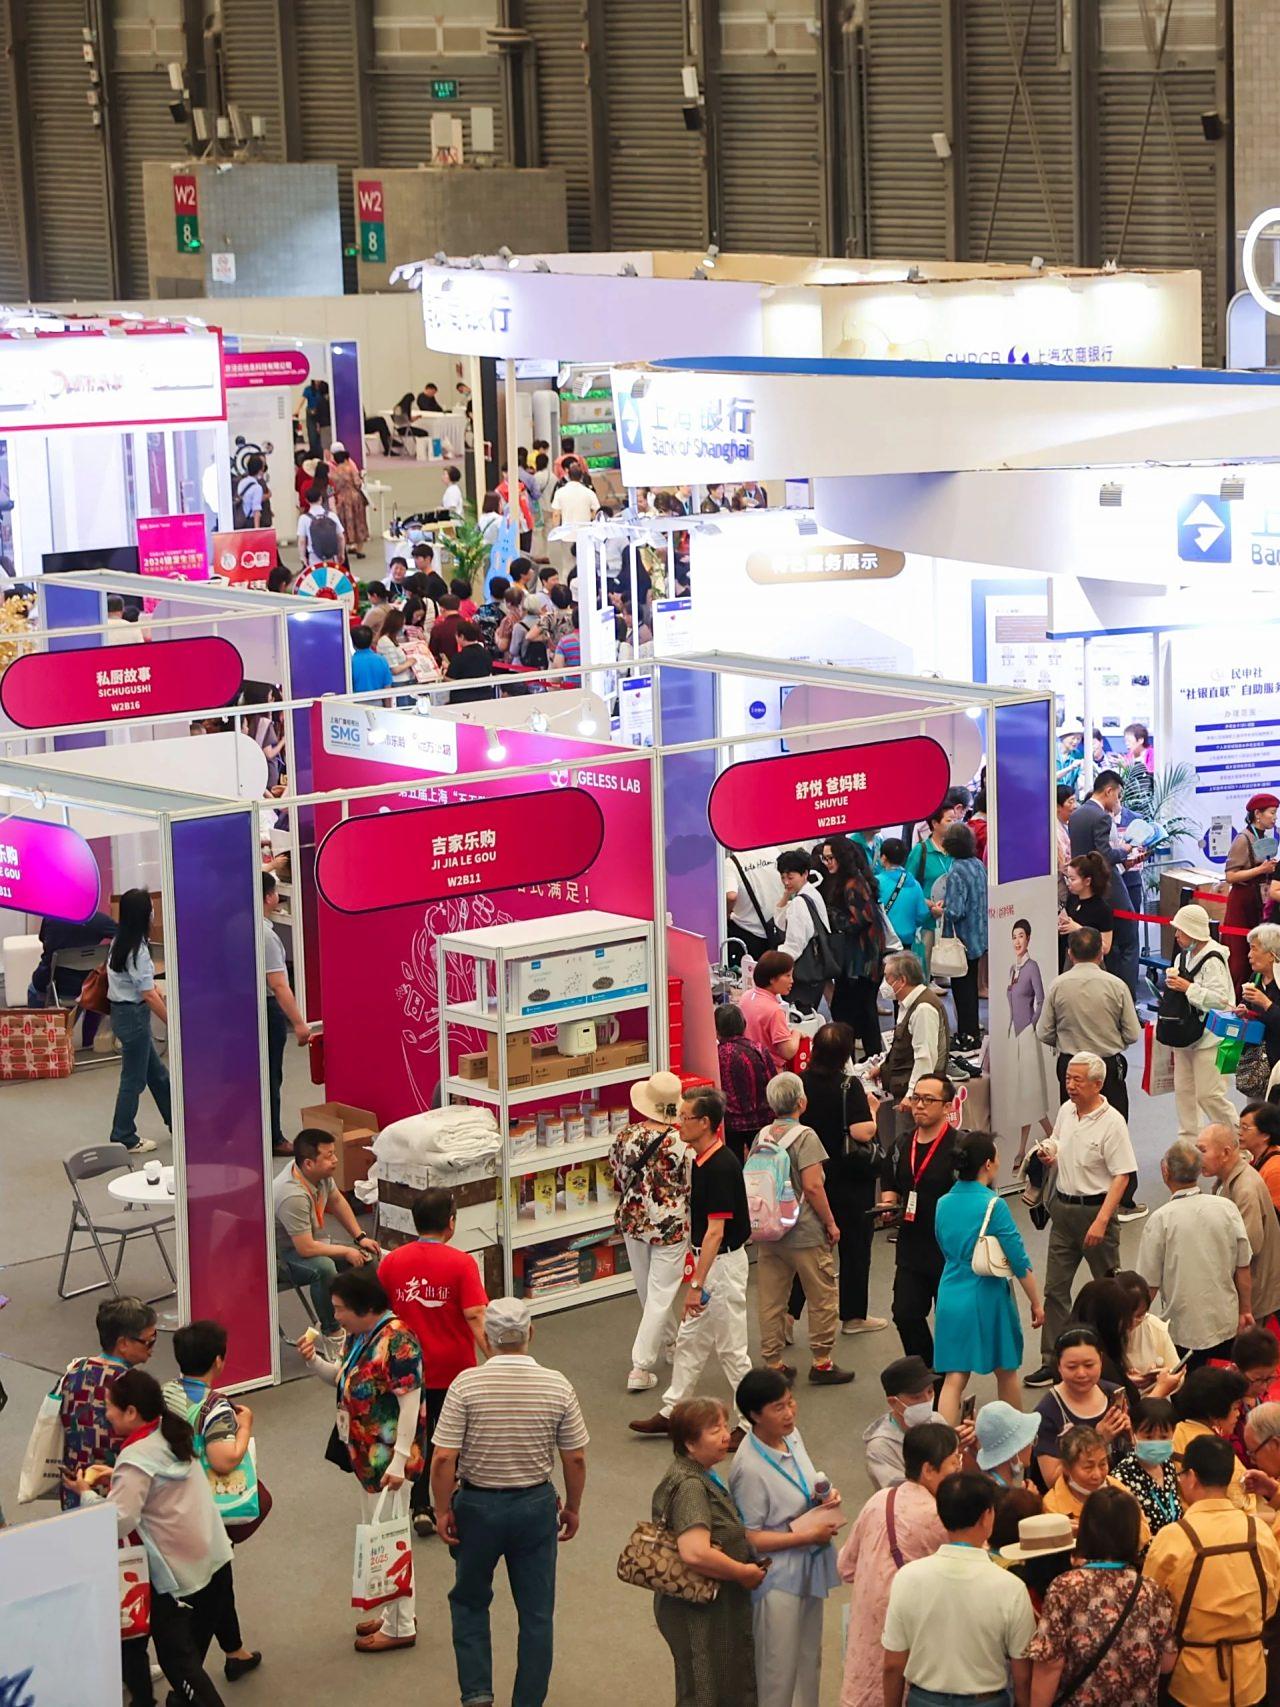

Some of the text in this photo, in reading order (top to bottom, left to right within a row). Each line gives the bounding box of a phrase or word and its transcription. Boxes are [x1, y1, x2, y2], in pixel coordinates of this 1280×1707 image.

[175, 185, 196, 206] W2
[360, 191, 382, 213] W2
[183, 224, 192, 243] 8
[367, 231, 378, 252] 8
[95, 666, 152, 687] 私厨故事
[97, 684, 152, 699] SICHUGUSHI
[110, 700, 141, 713] W2B16
[330, 725, 361, 743] SMG
[620, 772, 642, 794] LAB
[795, 772, 868, 800] 舒悦 爸妈鞋
[813, 796, 849, 810] SHUYUE
[817, 814, 848, 829] W2B12
[431, 828, 497, 857] 吉家乐购
[431, 850, 497, 871] JI JIA LE GOU
[4, 867, 21, 881] GOU
[447, 873, 482, 889] W2B11
